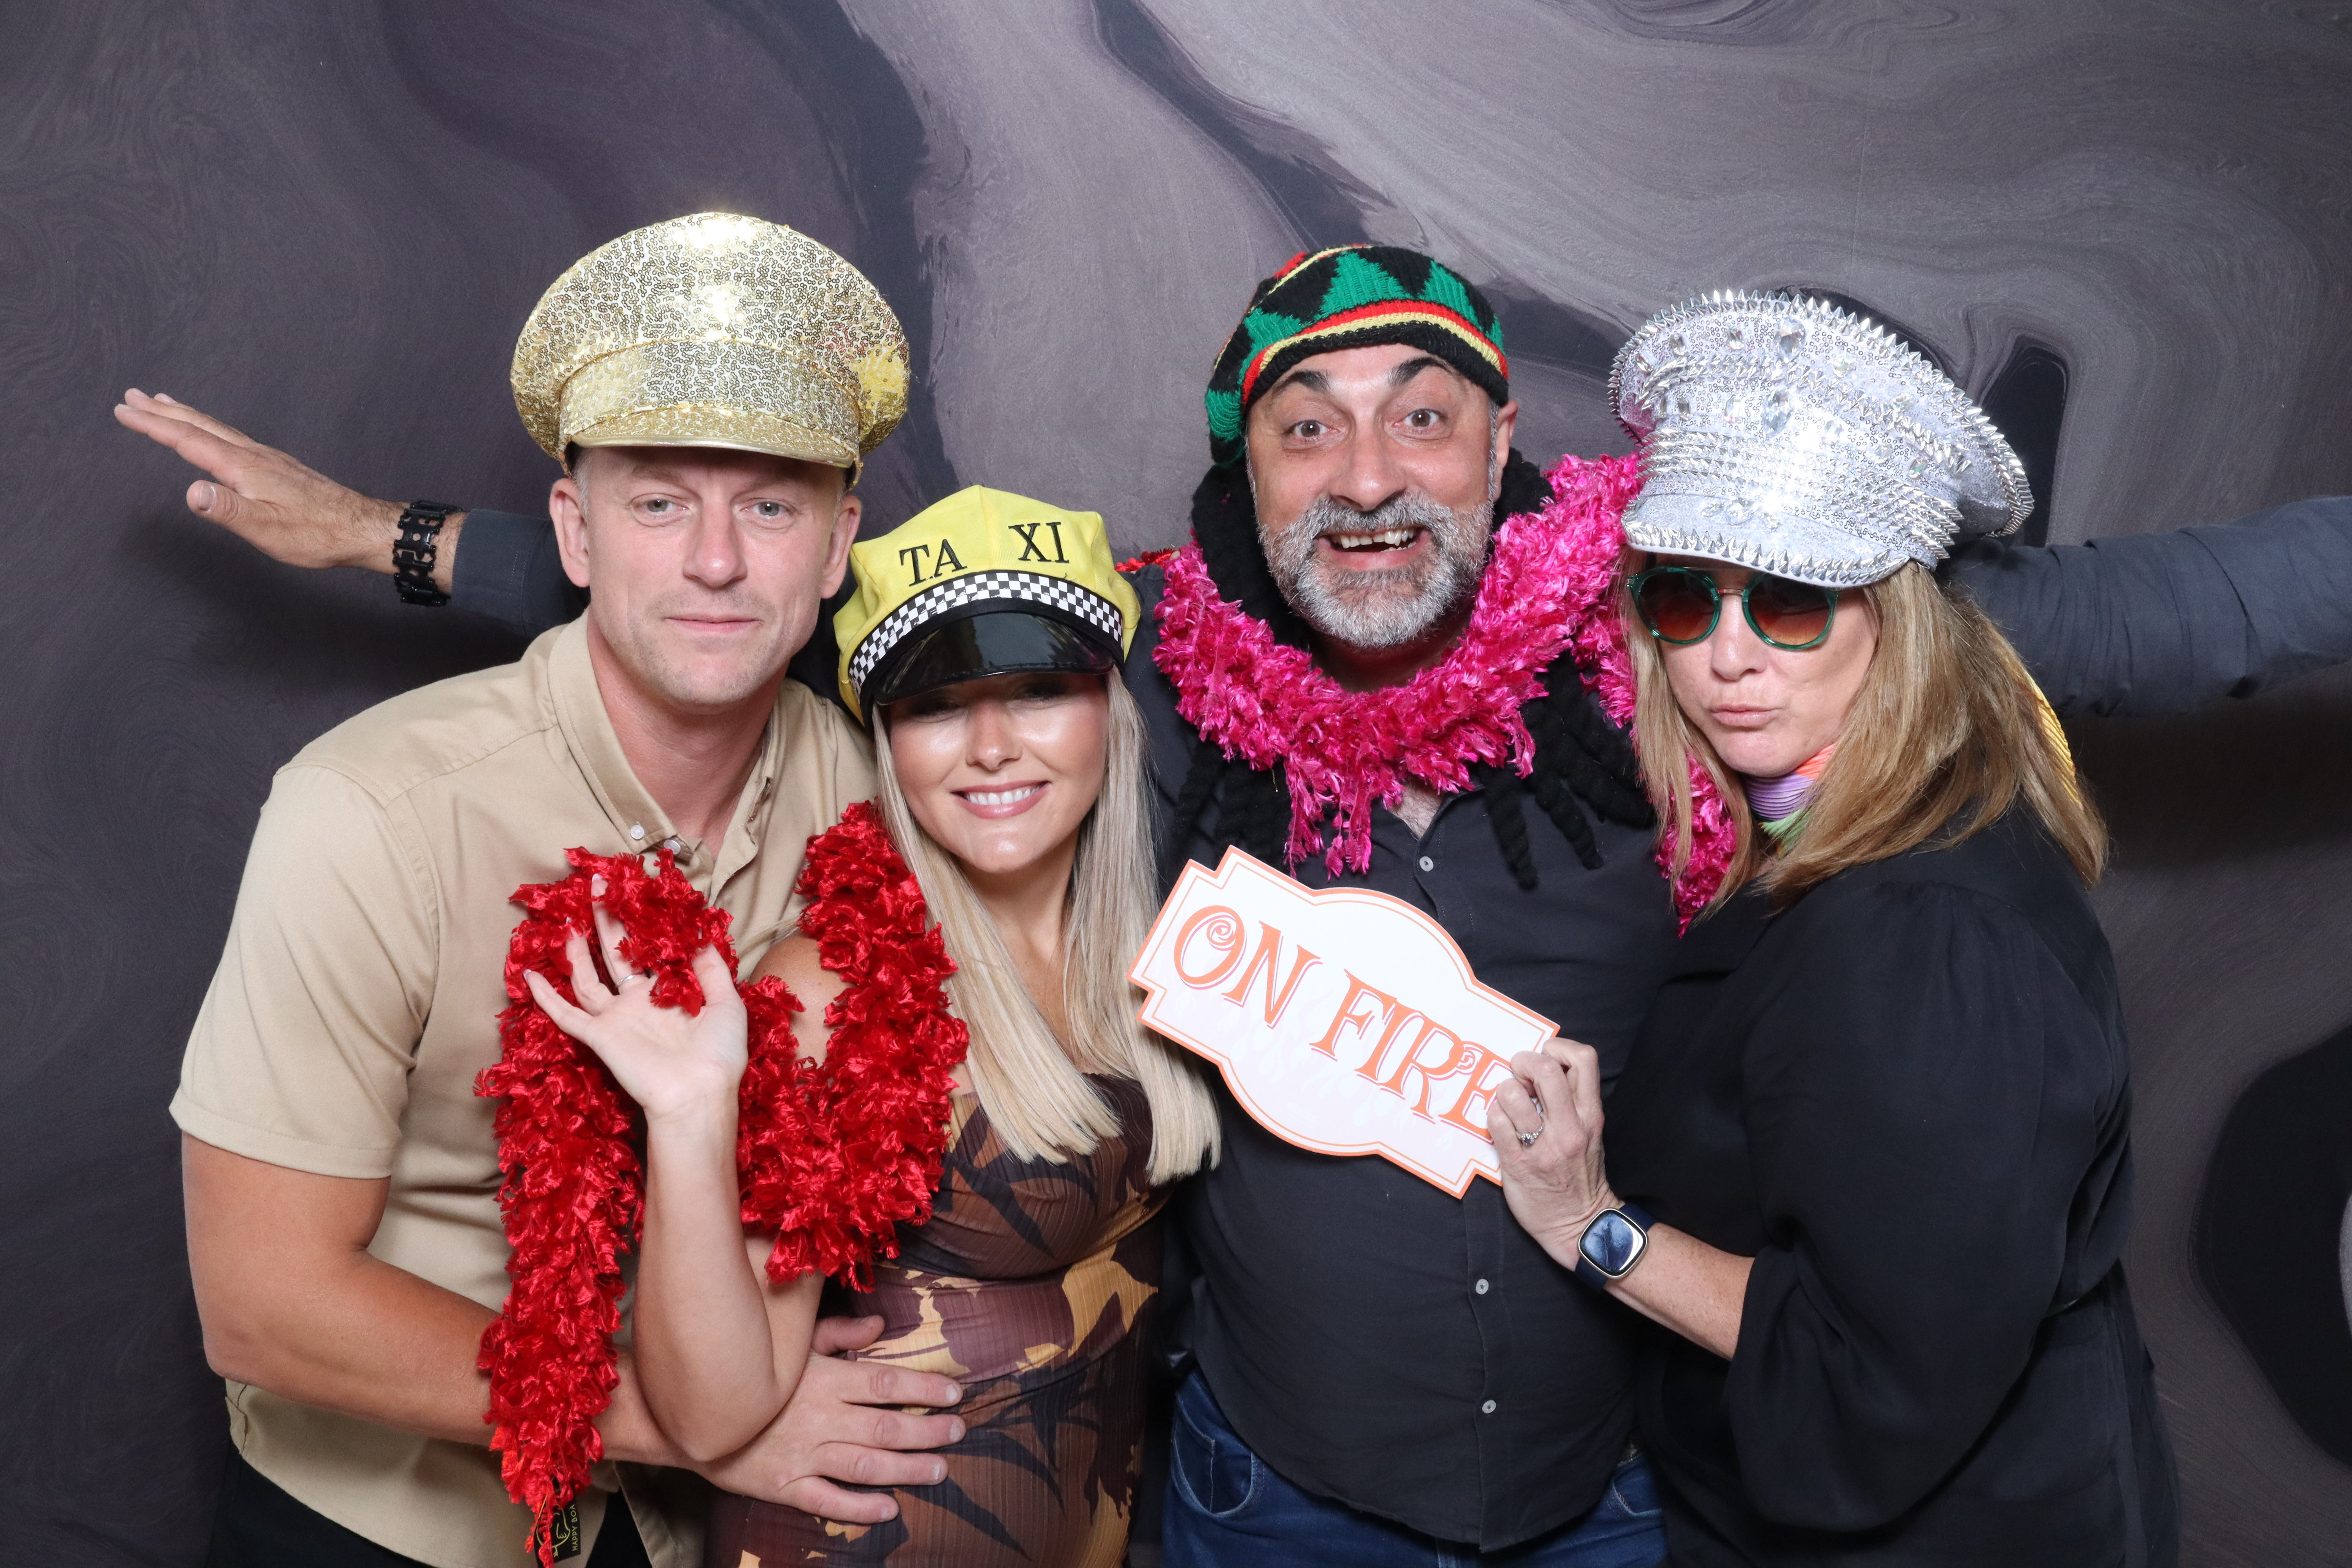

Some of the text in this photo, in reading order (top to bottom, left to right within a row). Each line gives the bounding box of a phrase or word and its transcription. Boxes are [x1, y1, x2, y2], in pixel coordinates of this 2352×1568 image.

[899, 522, 1069, 586] TA XI
[1174, 905, 1515, 1145] ON FIRE
